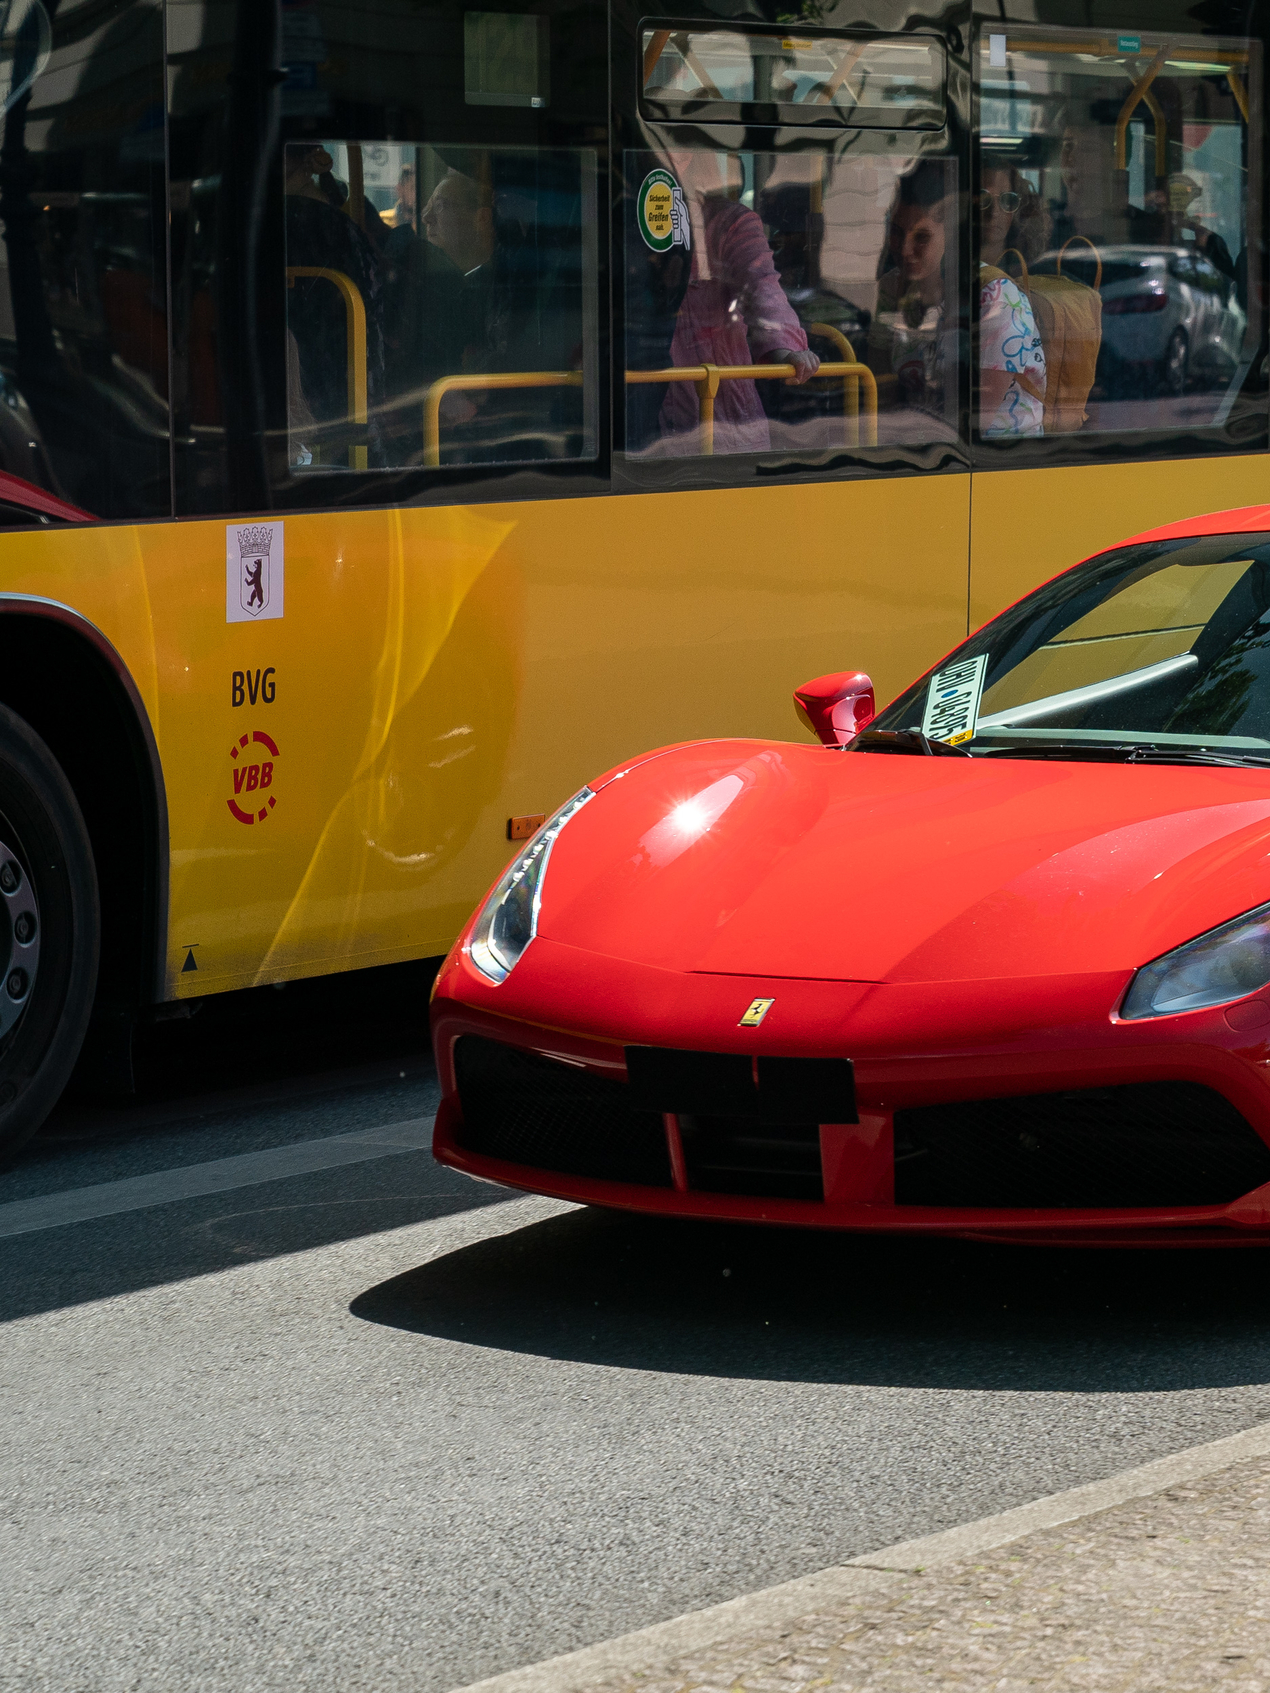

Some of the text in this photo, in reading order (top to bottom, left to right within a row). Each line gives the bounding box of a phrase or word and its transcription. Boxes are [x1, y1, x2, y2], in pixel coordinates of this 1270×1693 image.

[648, 212, 669, 222] Greifen
[232, 667, 276, 707] BVG
[936, 661, 978, 693] OHV
[233, 762, 274, 795] VBB
